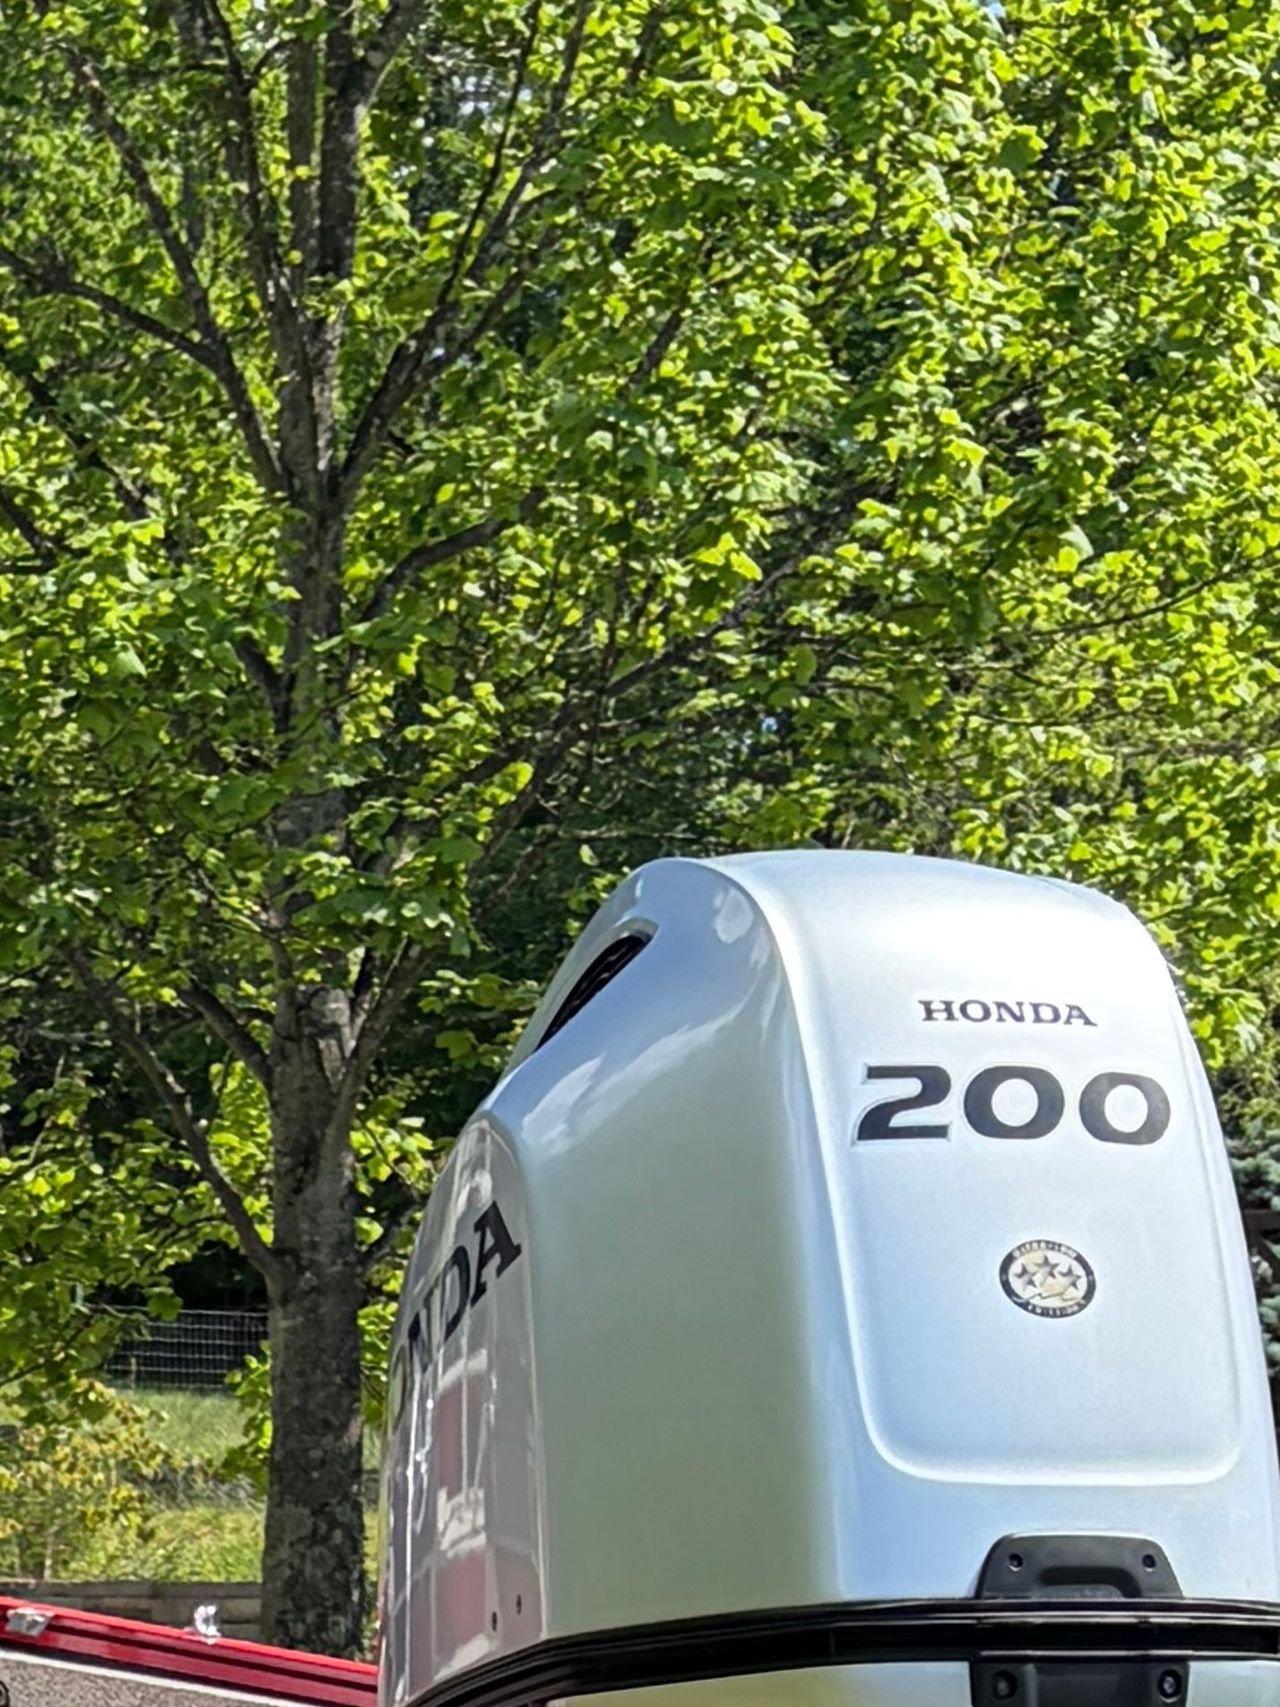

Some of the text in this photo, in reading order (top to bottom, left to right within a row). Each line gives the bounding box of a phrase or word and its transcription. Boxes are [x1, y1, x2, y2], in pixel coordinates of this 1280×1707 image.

[917, 999, 1099, 1027] HONDA
[856, 1064, 1172, 1147] 200
[391, 1200, 523, 1436] ONDA
